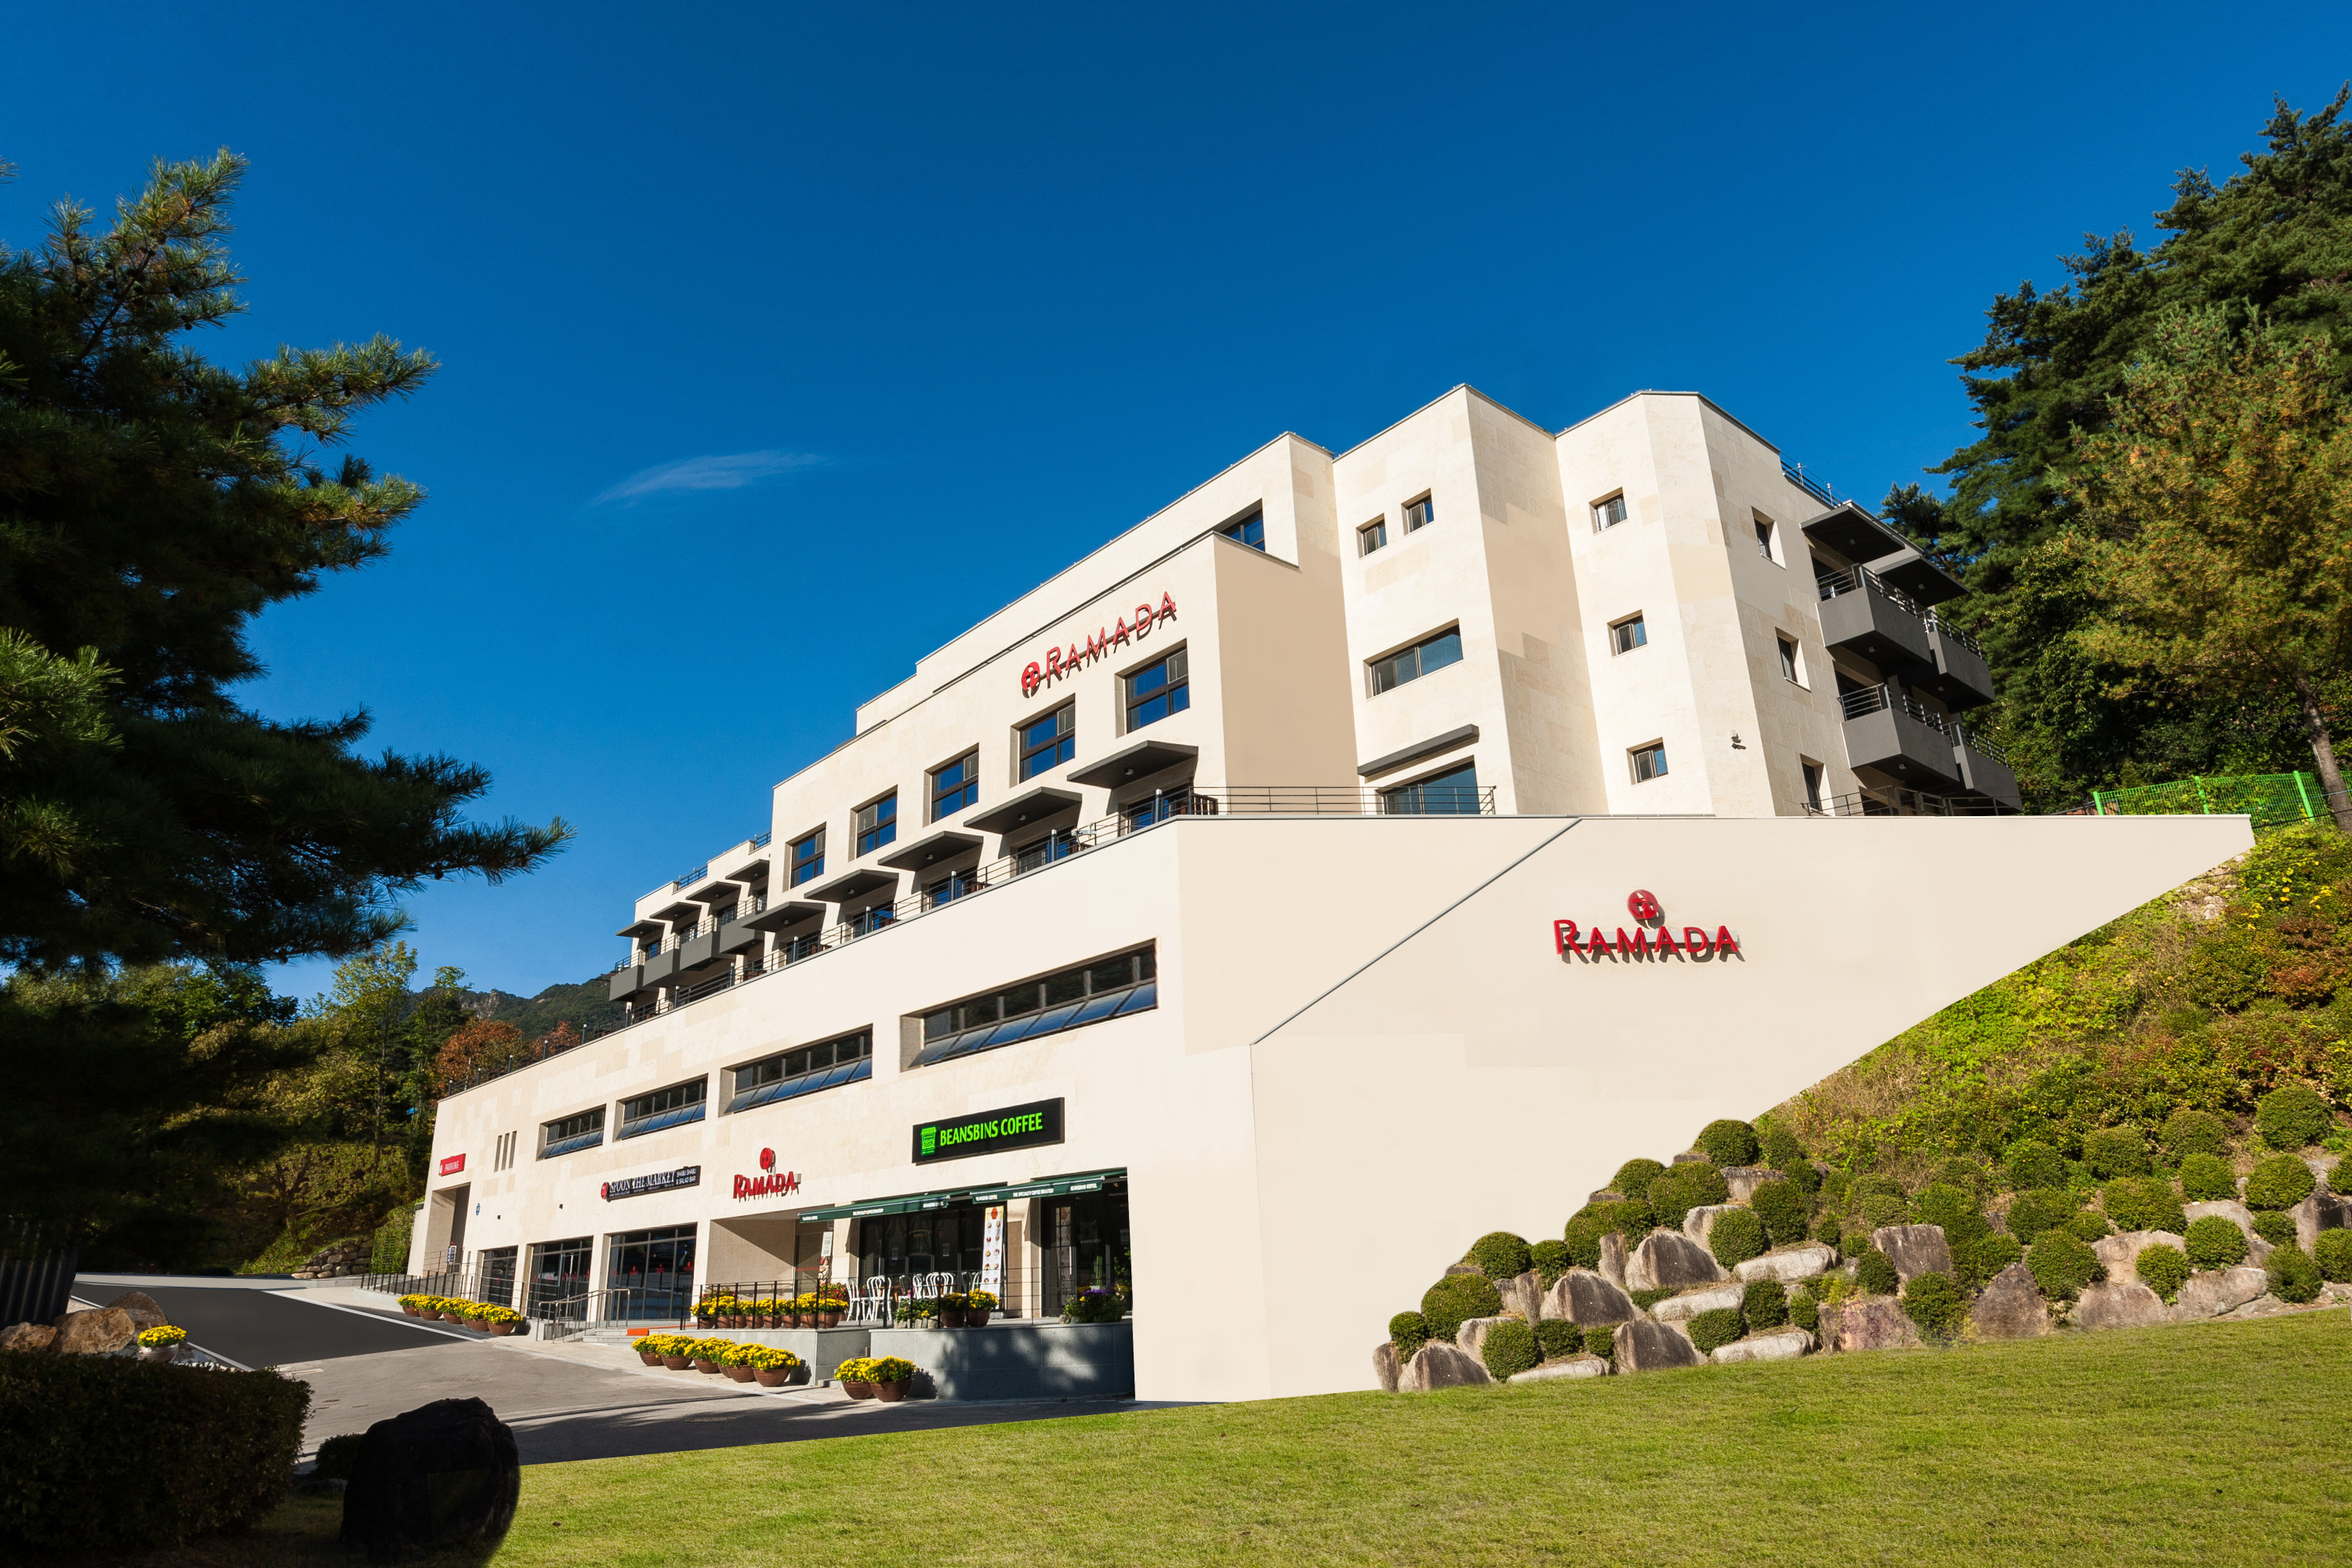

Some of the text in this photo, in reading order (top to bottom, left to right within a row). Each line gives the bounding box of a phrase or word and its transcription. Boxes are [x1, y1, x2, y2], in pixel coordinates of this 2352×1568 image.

[1046, 590, 1177, 681] RAMADA
[1553, 919, 1740, 955] RAMADA
[939, 1112, 1044, 1146] BEANSBINS COFFEE
[445, 1160, 459, 1172] PARKING
[609, 1179, 630, 1193] SPOON
[632, 1175, 646, 1189] THE
[646, 1171, 676, 1186] MARKET
[733, 1171, 796, 1199] RAMADA
